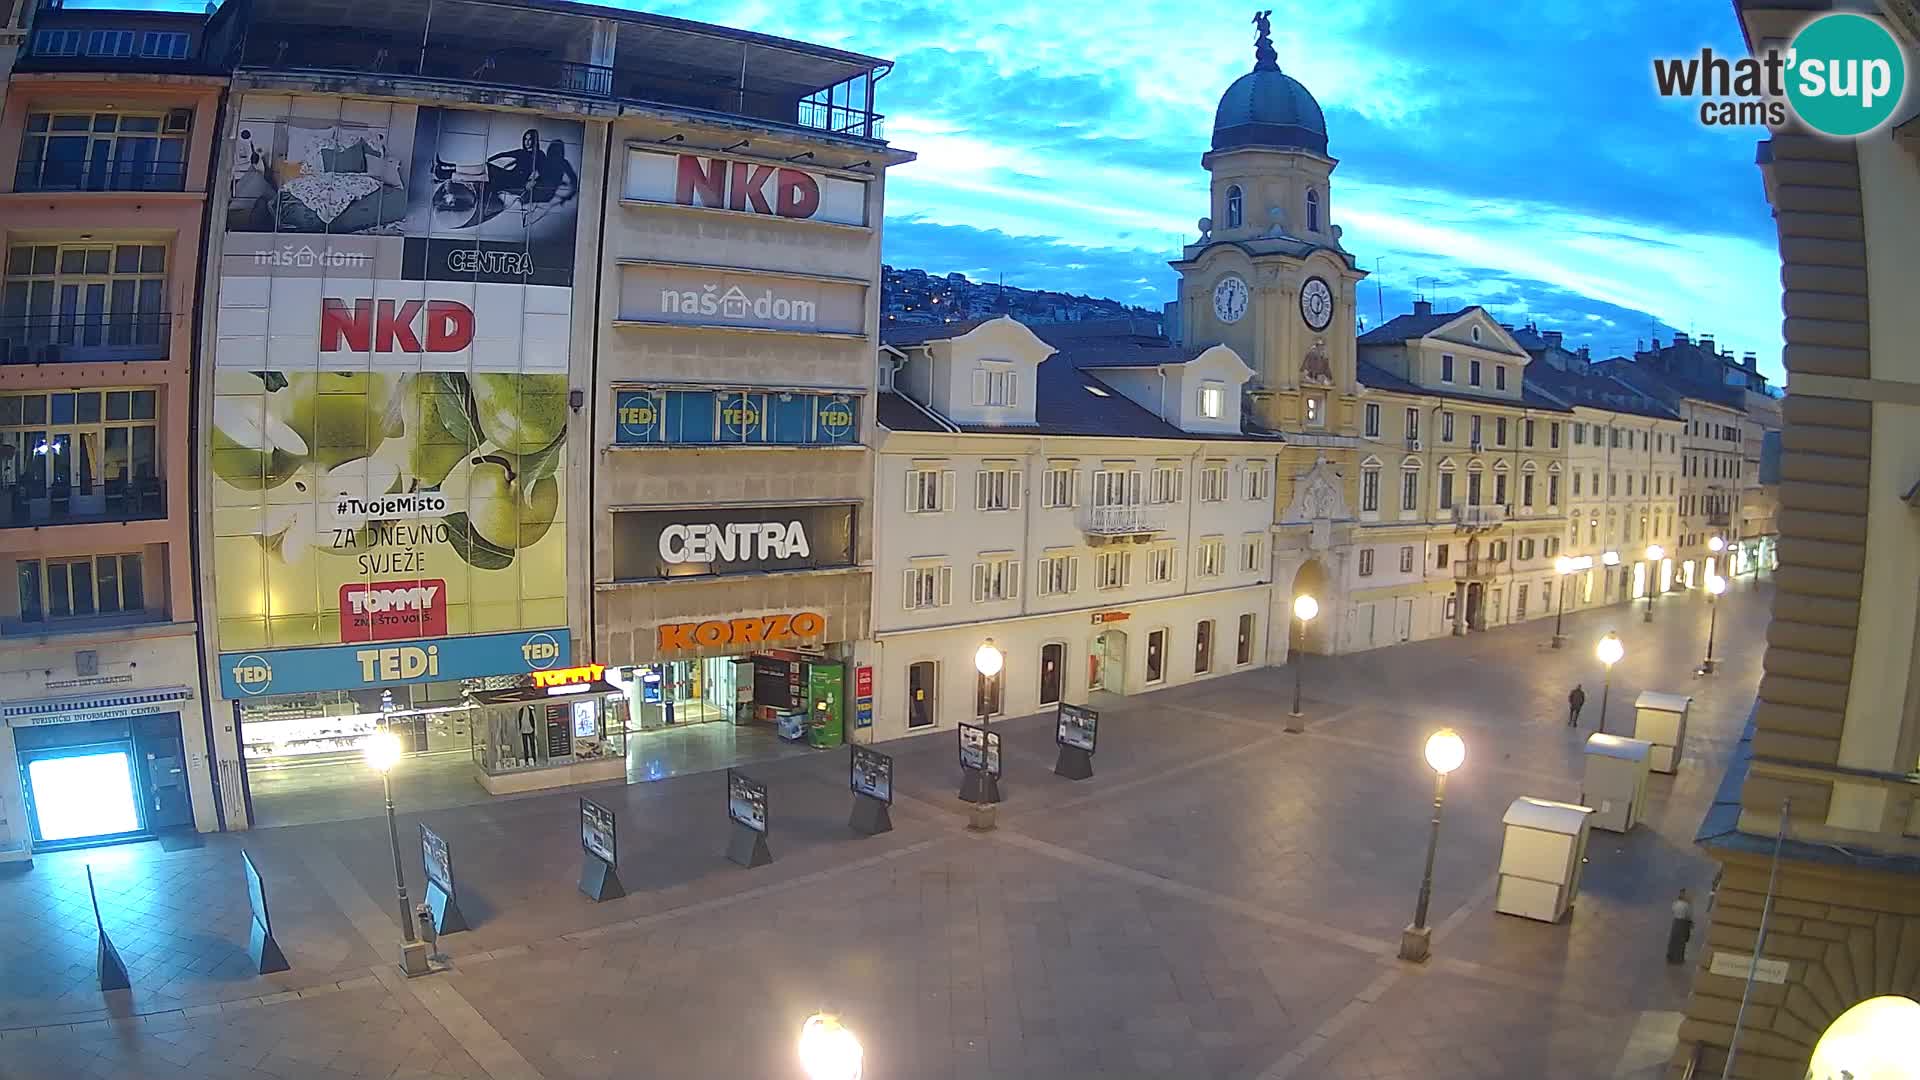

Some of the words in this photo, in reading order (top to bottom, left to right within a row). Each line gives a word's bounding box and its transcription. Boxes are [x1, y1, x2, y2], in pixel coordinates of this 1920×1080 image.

[676, 153, 820, 219] NKD
[254, 244, 293, 267] naš
[319, 245, 364, 267] dom
[447, 249, 534, 275] CENTRA
[662, 283, 717, 316] naš
[754, 290, 815, 322] dom
[320, 298, 475, 352] NKD
[618, 407, 658, 425] TEDi
[723, 408, 760, 425] TEDi
[819, 410, 853, 426] TEDi
[337, 497, 445, 516] #TvojeMisto
[333, 528, 357, 548] ZA
[367, 523, 449, 547] DNEVNO
[658, 520, 810, 564] CENTRA
[358, 547, 425, 575] SVJEŽE
[348, 586, 439, 614] TOMMY
[657, 612, 825, 652] KORZO
[357, 645, 439, 683] TEDi
[521, 642, 559, 661] TEDi
[233, 666, 272, 683] TEDi
[532, 663, 606, 688] TOMMY
[131, 705, 161, 716] CENTAR
